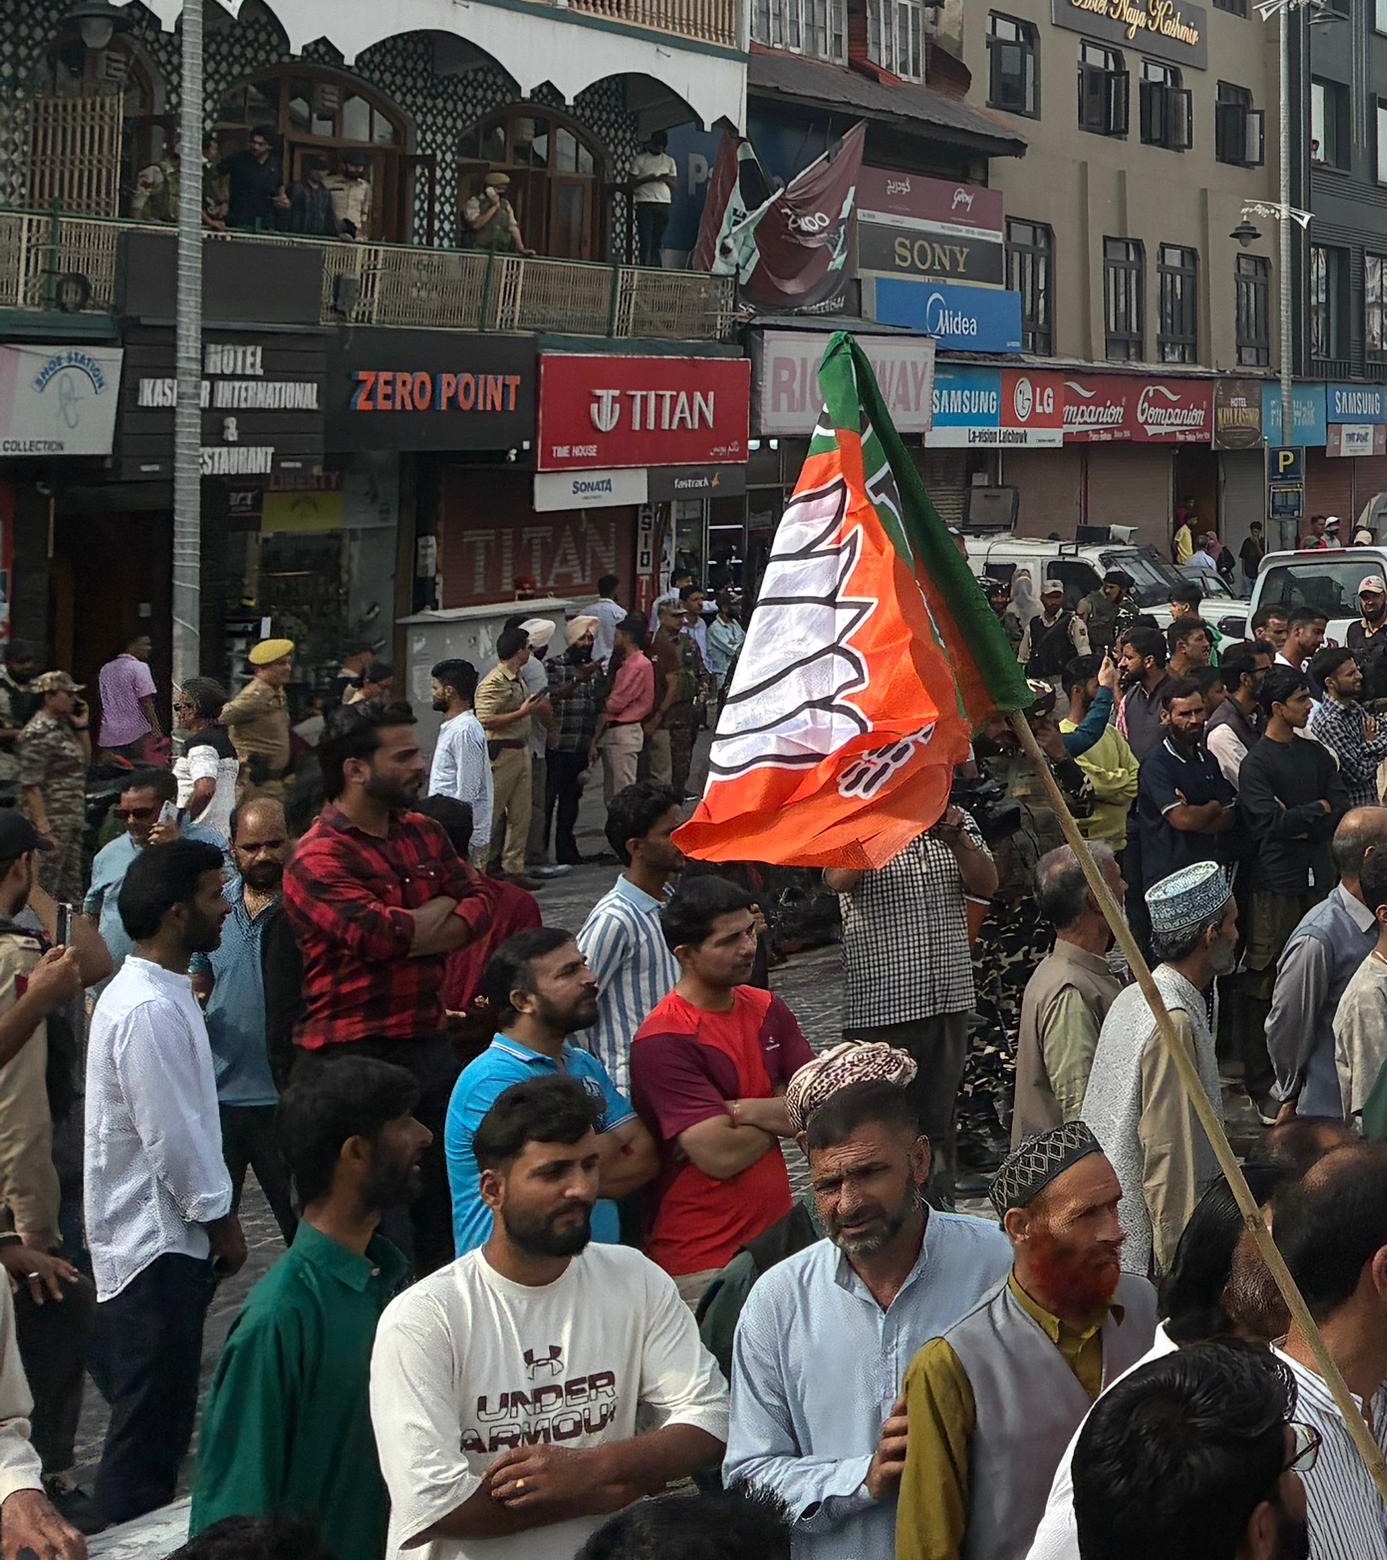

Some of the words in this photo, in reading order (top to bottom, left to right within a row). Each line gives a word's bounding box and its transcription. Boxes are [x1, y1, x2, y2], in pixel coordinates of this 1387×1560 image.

[894, 236, 970, 273] SONY
[930, 298, 977, 337] Midea
[204, 344, 263, 375] HOTEL
[213, 382, 318, 409] INTERNATIONAL
[351, 371, 432, 412] ZERO
[436, 374, 520, 412] POINT
[933, 389, 997, 415] SAMSUNG
[1035, 387, 1054, 415] LG
[1230, 398, 1247, 407] HOTEL
[1335, 391, 1380, 414] SAMSUNG
[626, 391, 714, 431] TITAN
[1063, 400, 1124, 430] mpanion
[1137, 385, 1206, 431] Companion
[3, 439, 64, 453] COLLECTION
[552, 445, 571, 458] TIME
[573, 444, 598, 457] HOUSE
[1279, 451, 1294, 472] P
[572, 478, 612, 495] SONATA
[674, 476, 709, 489] fastrack
[463, 520, 616, 595] TITAN
[477, 1370, 616, 1423] UNDER
